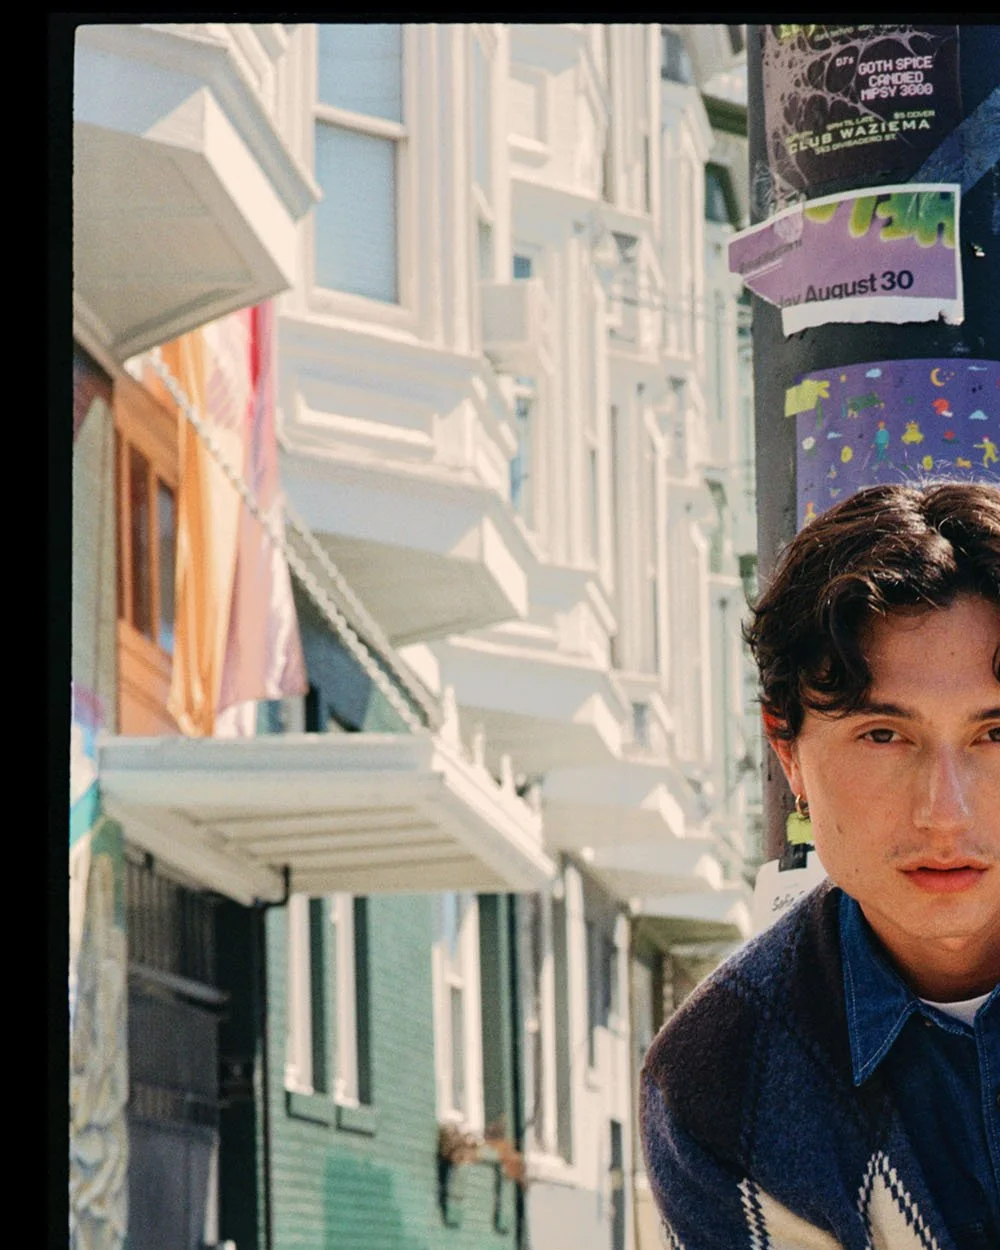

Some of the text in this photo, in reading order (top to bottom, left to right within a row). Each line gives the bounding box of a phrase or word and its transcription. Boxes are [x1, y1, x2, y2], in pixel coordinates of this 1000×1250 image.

[858, 56, 933, 75] GOTH SPICE
[868, 71, 924, 87] CANDIED
[899, 83, 934, 96] 3000
[788, 132, 833, 156] CLUB
[840, 119, 931, 140] WAZIEMA
[805, 272, 878, 303] August
[881, 269, 914, 291] 30
